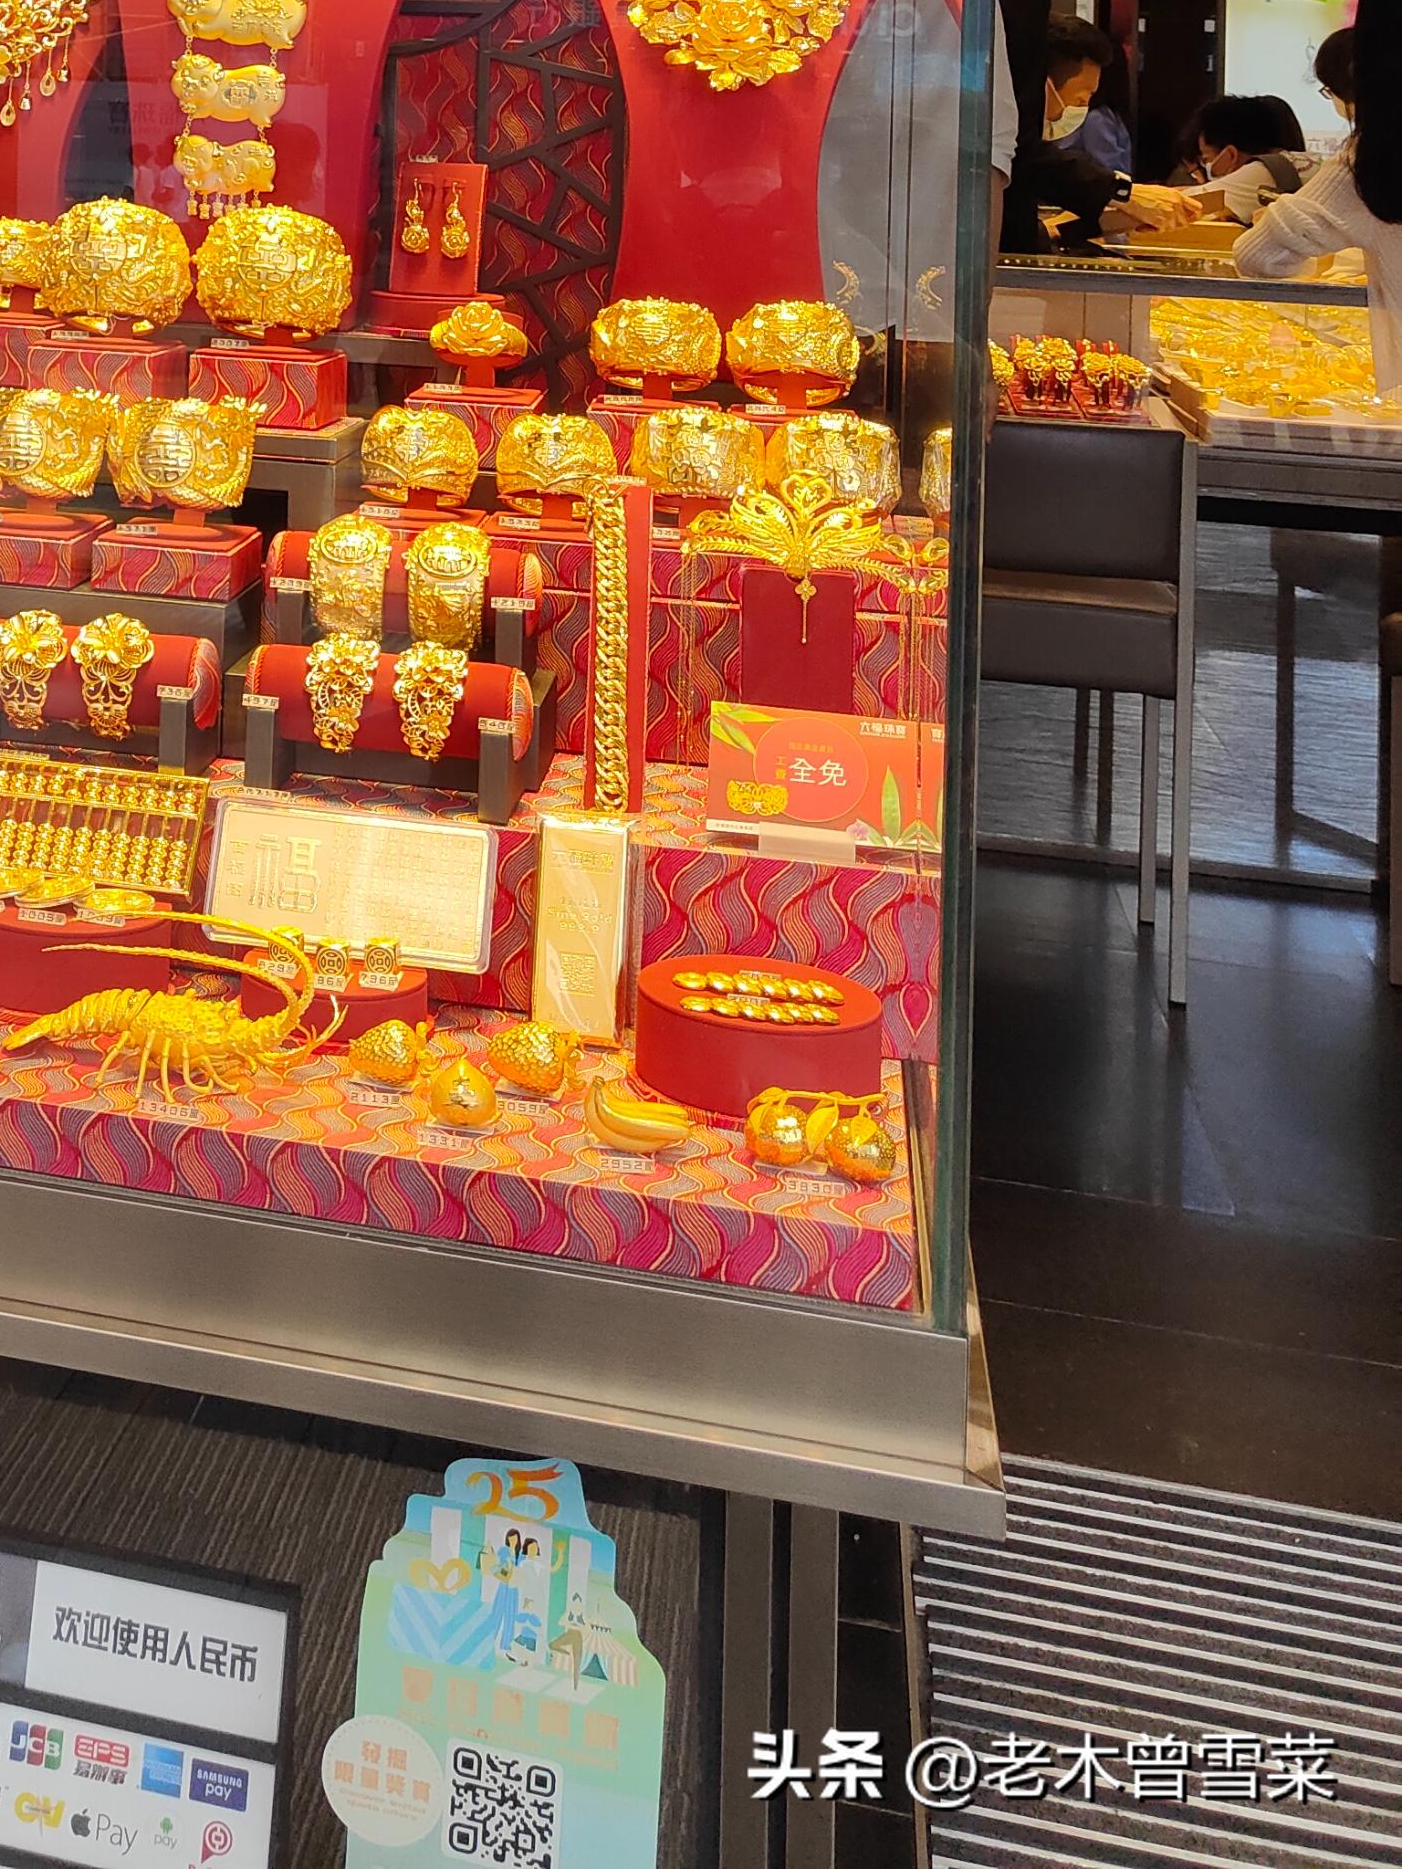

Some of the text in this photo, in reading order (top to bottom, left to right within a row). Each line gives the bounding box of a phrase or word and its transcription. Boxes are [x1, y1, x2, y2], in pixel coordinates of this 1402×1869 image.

[788, 757, 847, 787] 全免
[466, 1462, 565, 1523] 25
[52, 1605, 259, 1683] 欢迎使用人民币
[197, 1769, 243, 1789] SAMSUNG
[205, 1782, 232, 1801] pay
[95, 1812, 138, 1856] Pay
[154, 1833, 178, 1851] pay
